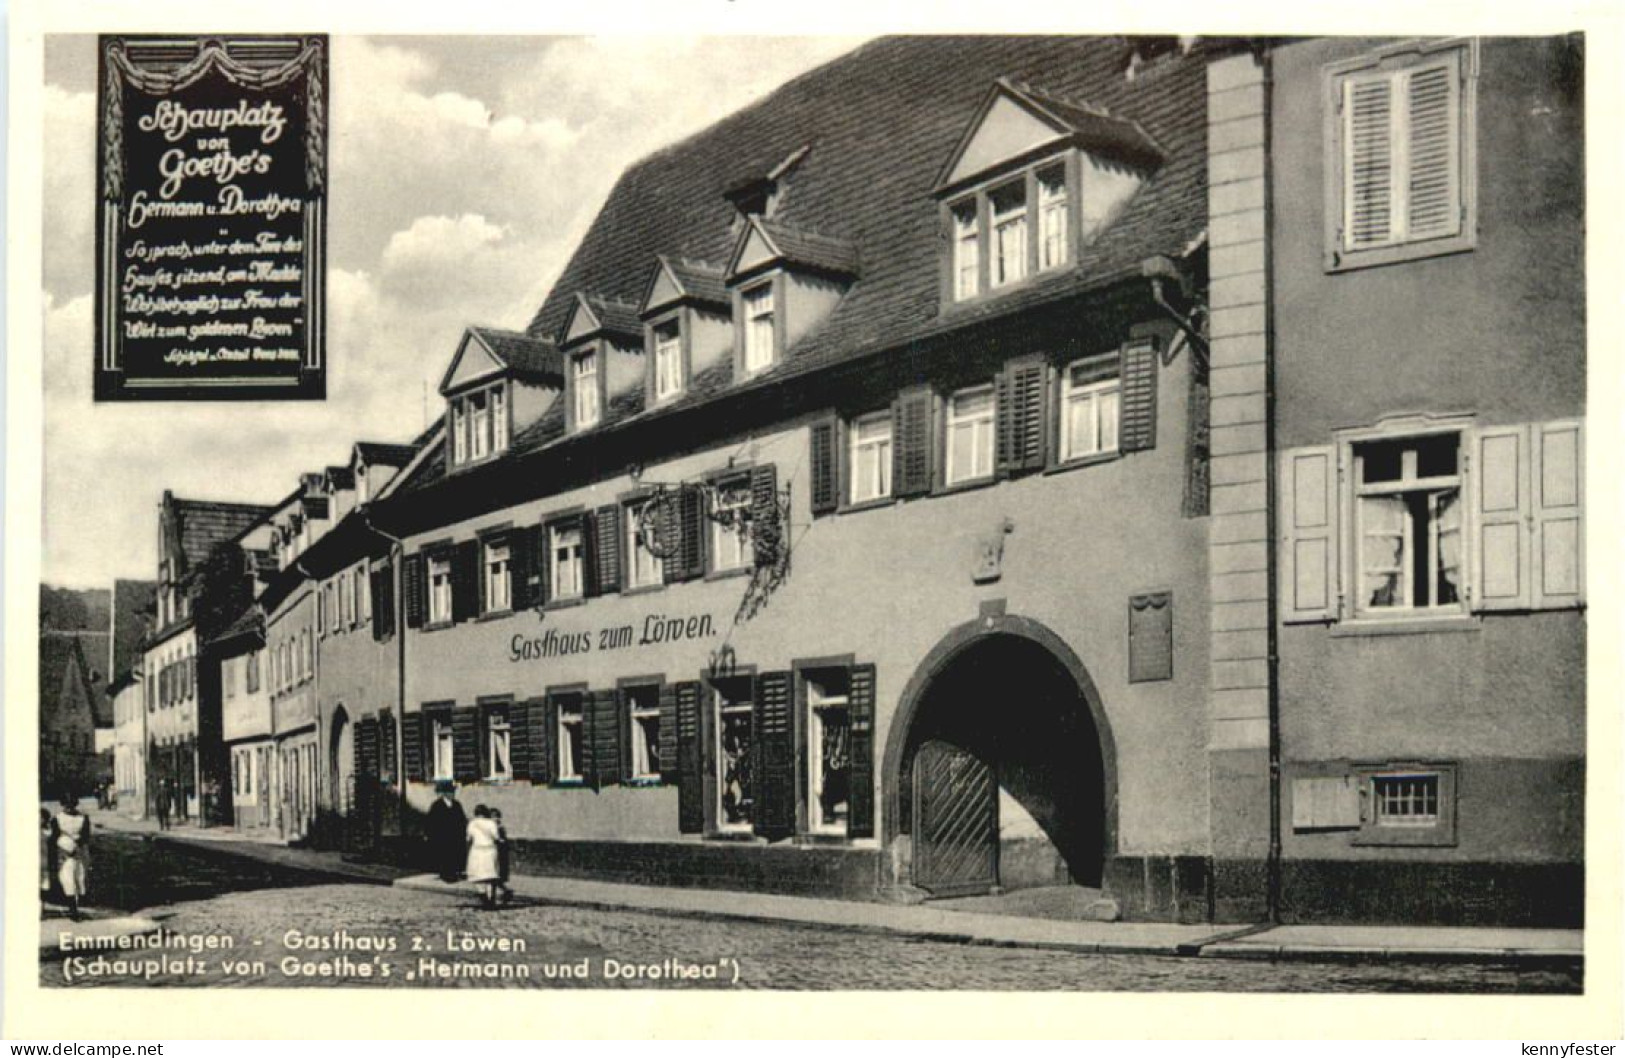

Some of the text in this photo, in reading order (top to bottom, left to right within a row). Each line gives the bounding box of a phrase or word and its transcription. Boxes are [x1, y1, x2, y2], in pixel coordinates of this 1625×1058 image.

[138, 100, 286, 143] Schauplatz
[197, 137, 229, 150] von
[158, 149, 272, 199] Goethe's
[128, 190, 204, 228] Hermann
[218, 184, 301, 220] Dorothea
[510, 613, 717, 662] Gasthaus zum Löwen.
